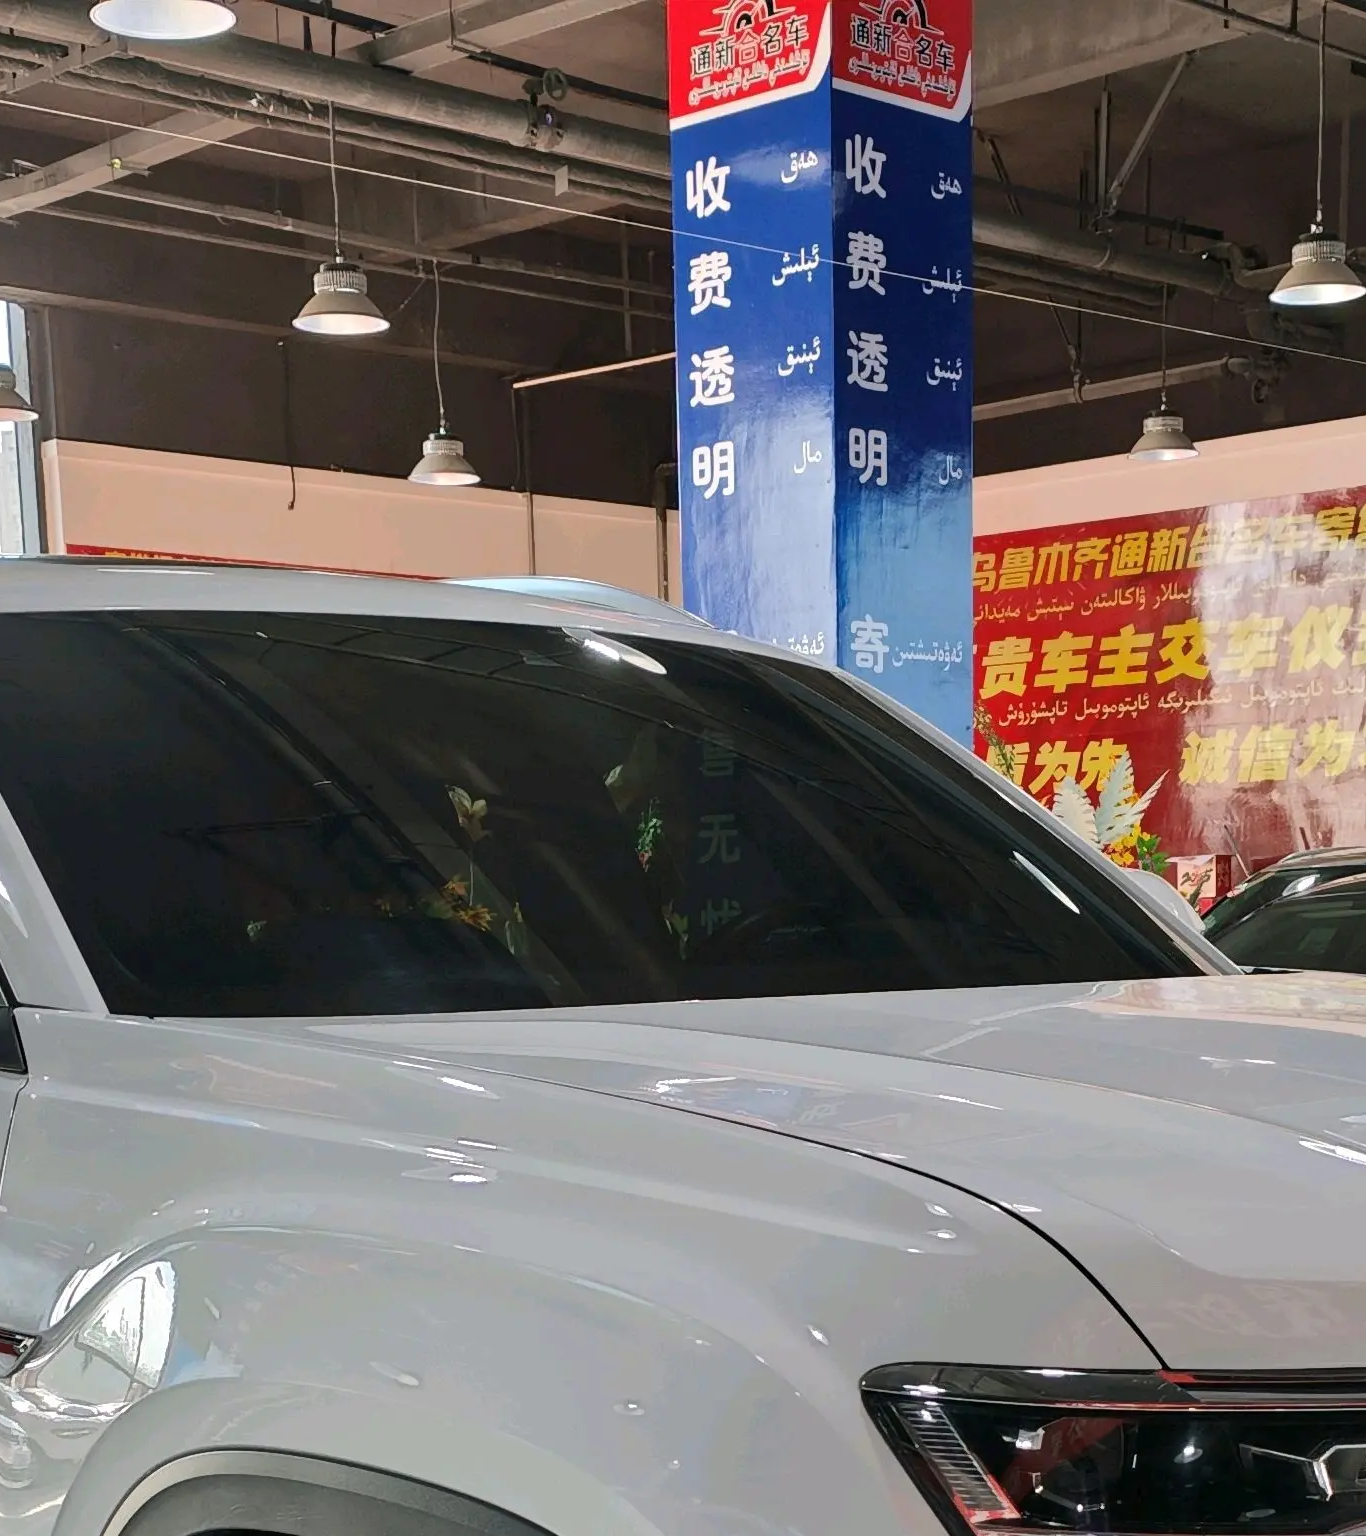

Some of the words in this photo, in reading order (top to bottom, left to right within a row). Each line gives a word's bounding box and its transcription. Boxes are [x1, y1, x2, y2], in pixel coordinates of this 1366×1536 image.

[689, 15, 809, 78] 通新合名车
[849, 13, 955, 73] 通新合名车
[686, 156, 735, 499] 收费透明
[845, 134, 889, 486] 收费透明
[850, 614, 889, 674] 寄
